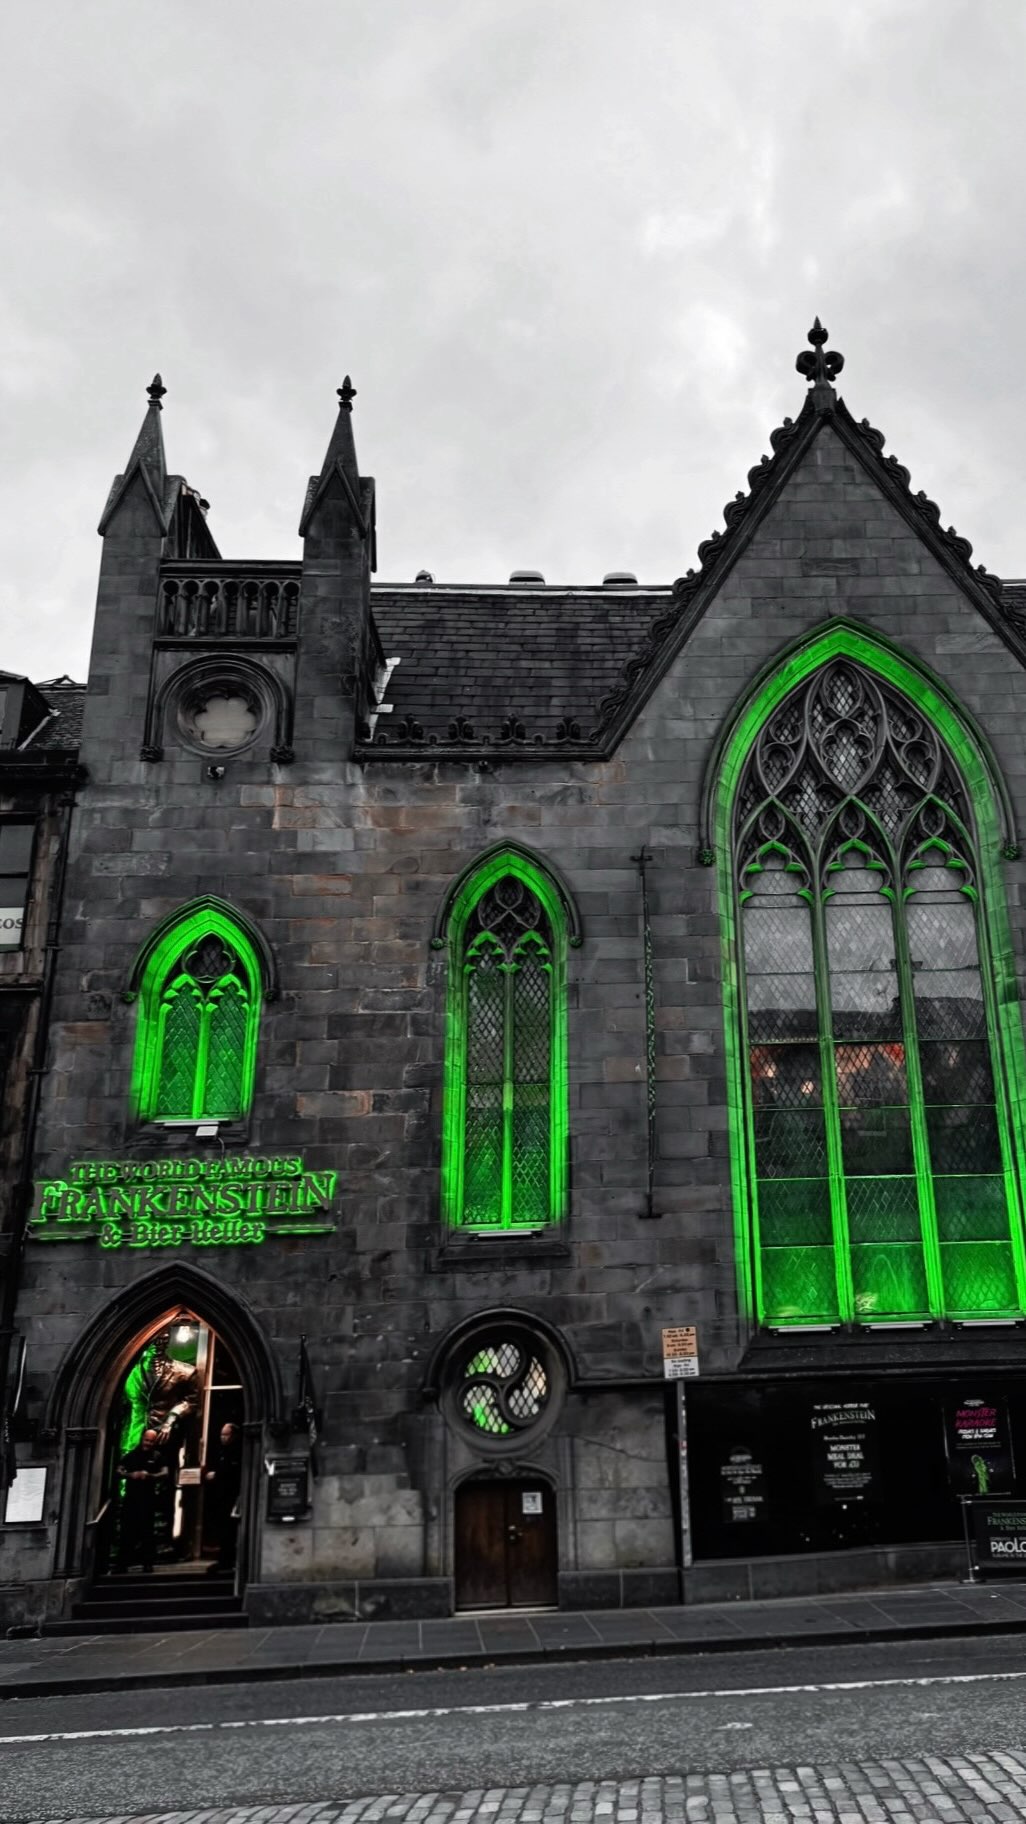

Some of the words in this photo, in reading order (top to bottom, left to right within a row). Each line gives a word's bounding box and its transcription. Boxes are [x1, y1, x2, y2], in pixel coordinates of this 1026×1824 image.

[70, 1161, 117, 1184] THE
[120, 1159, 201, 1182] WORLD
[204, 1156, 302, 1180] FAMOUS
[30, 1171, 337, 1223] FRANKENSTEIN
[100, 1222, 122, 1247] &
[129, 1220, 184, 1246] Bier
[191, 1218, 265, 1244] Keller
